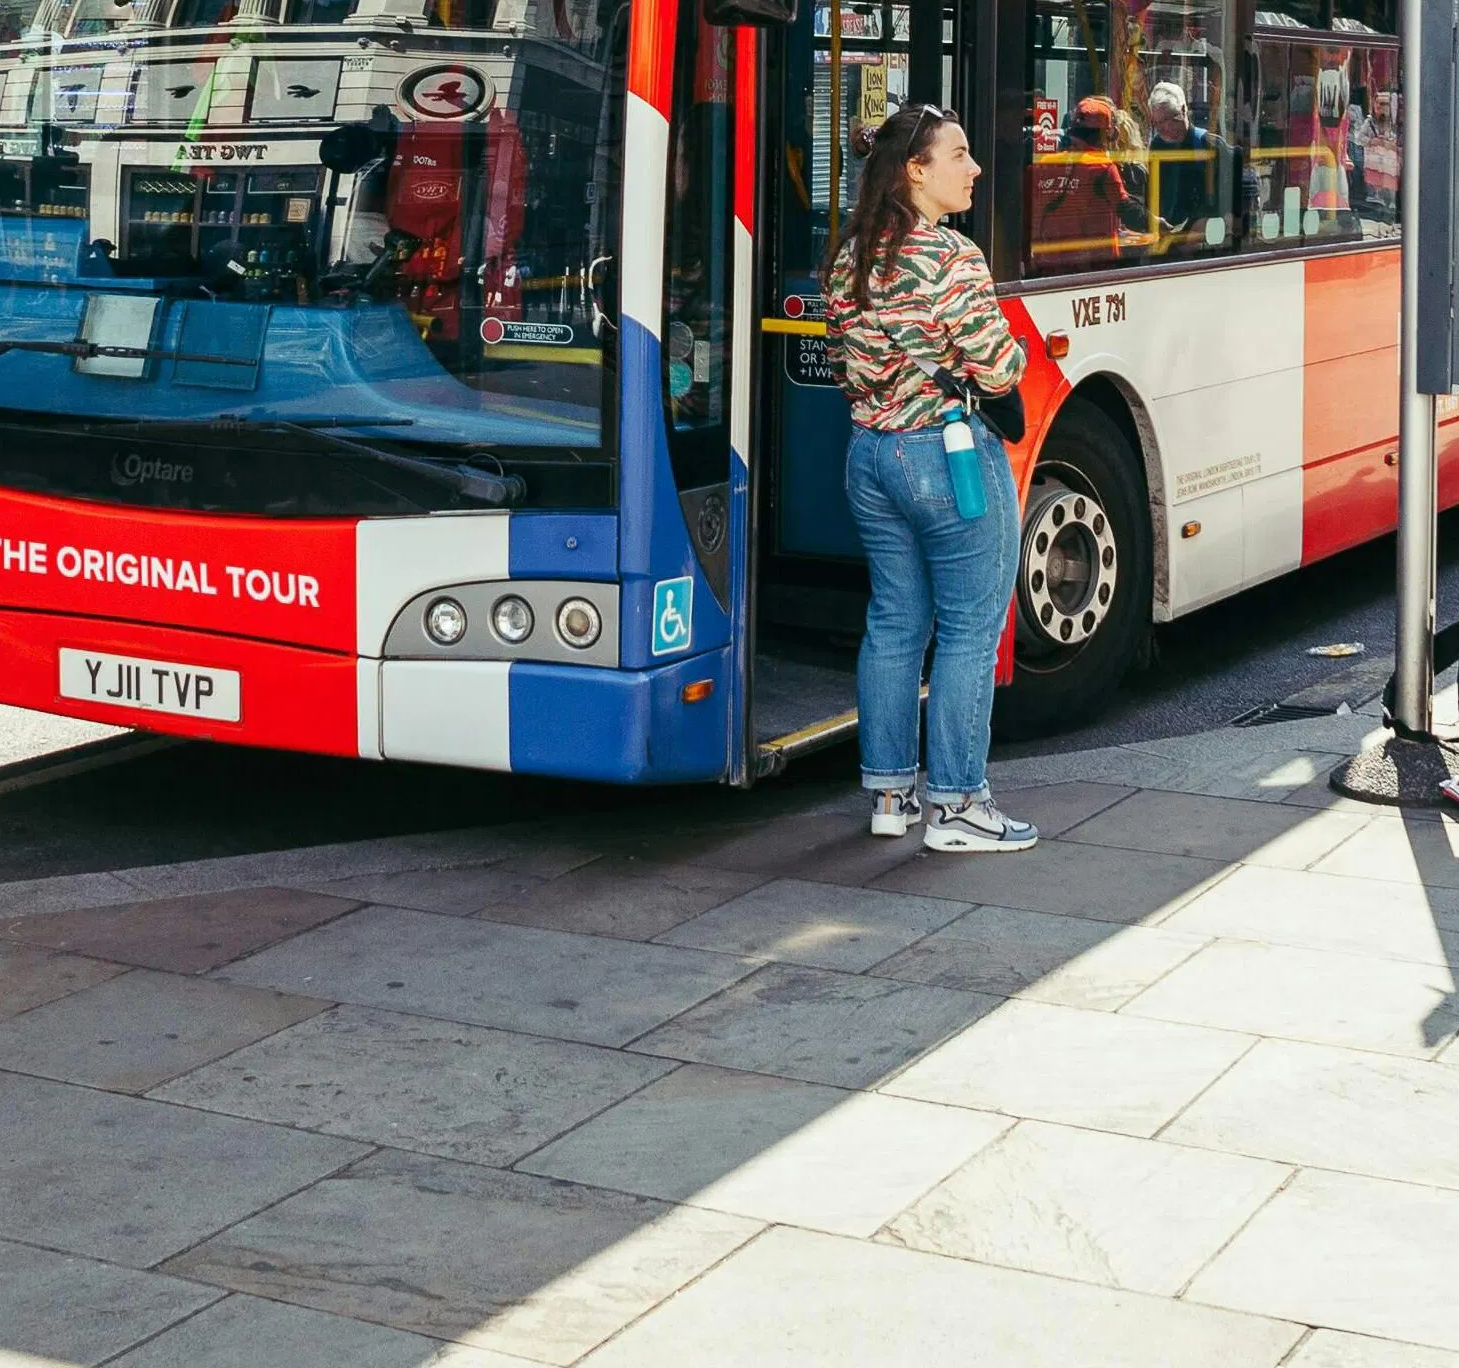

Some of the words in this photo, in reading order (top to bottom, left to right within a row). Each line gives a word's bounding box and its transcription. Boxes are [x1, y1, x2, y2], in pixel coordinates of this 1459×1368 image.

[1072, 296, 1100, 328] VXE
[1106, 292, 1125, 323] 731
[507, 324, 522, 332] PUSH
[547, 326, 563, 334] OPEN
[522, 332, 556, 341] EMERGENCY
[801, 353, 818, 364] OR
[125, 453, 194, 484] Optare
[56, 545, 217, 596] ORIGINAL
[226, 565, 320, 608] TOUR
[85, 658, 140, 701] YJ11
[152, 669, 213, 710] TVP
